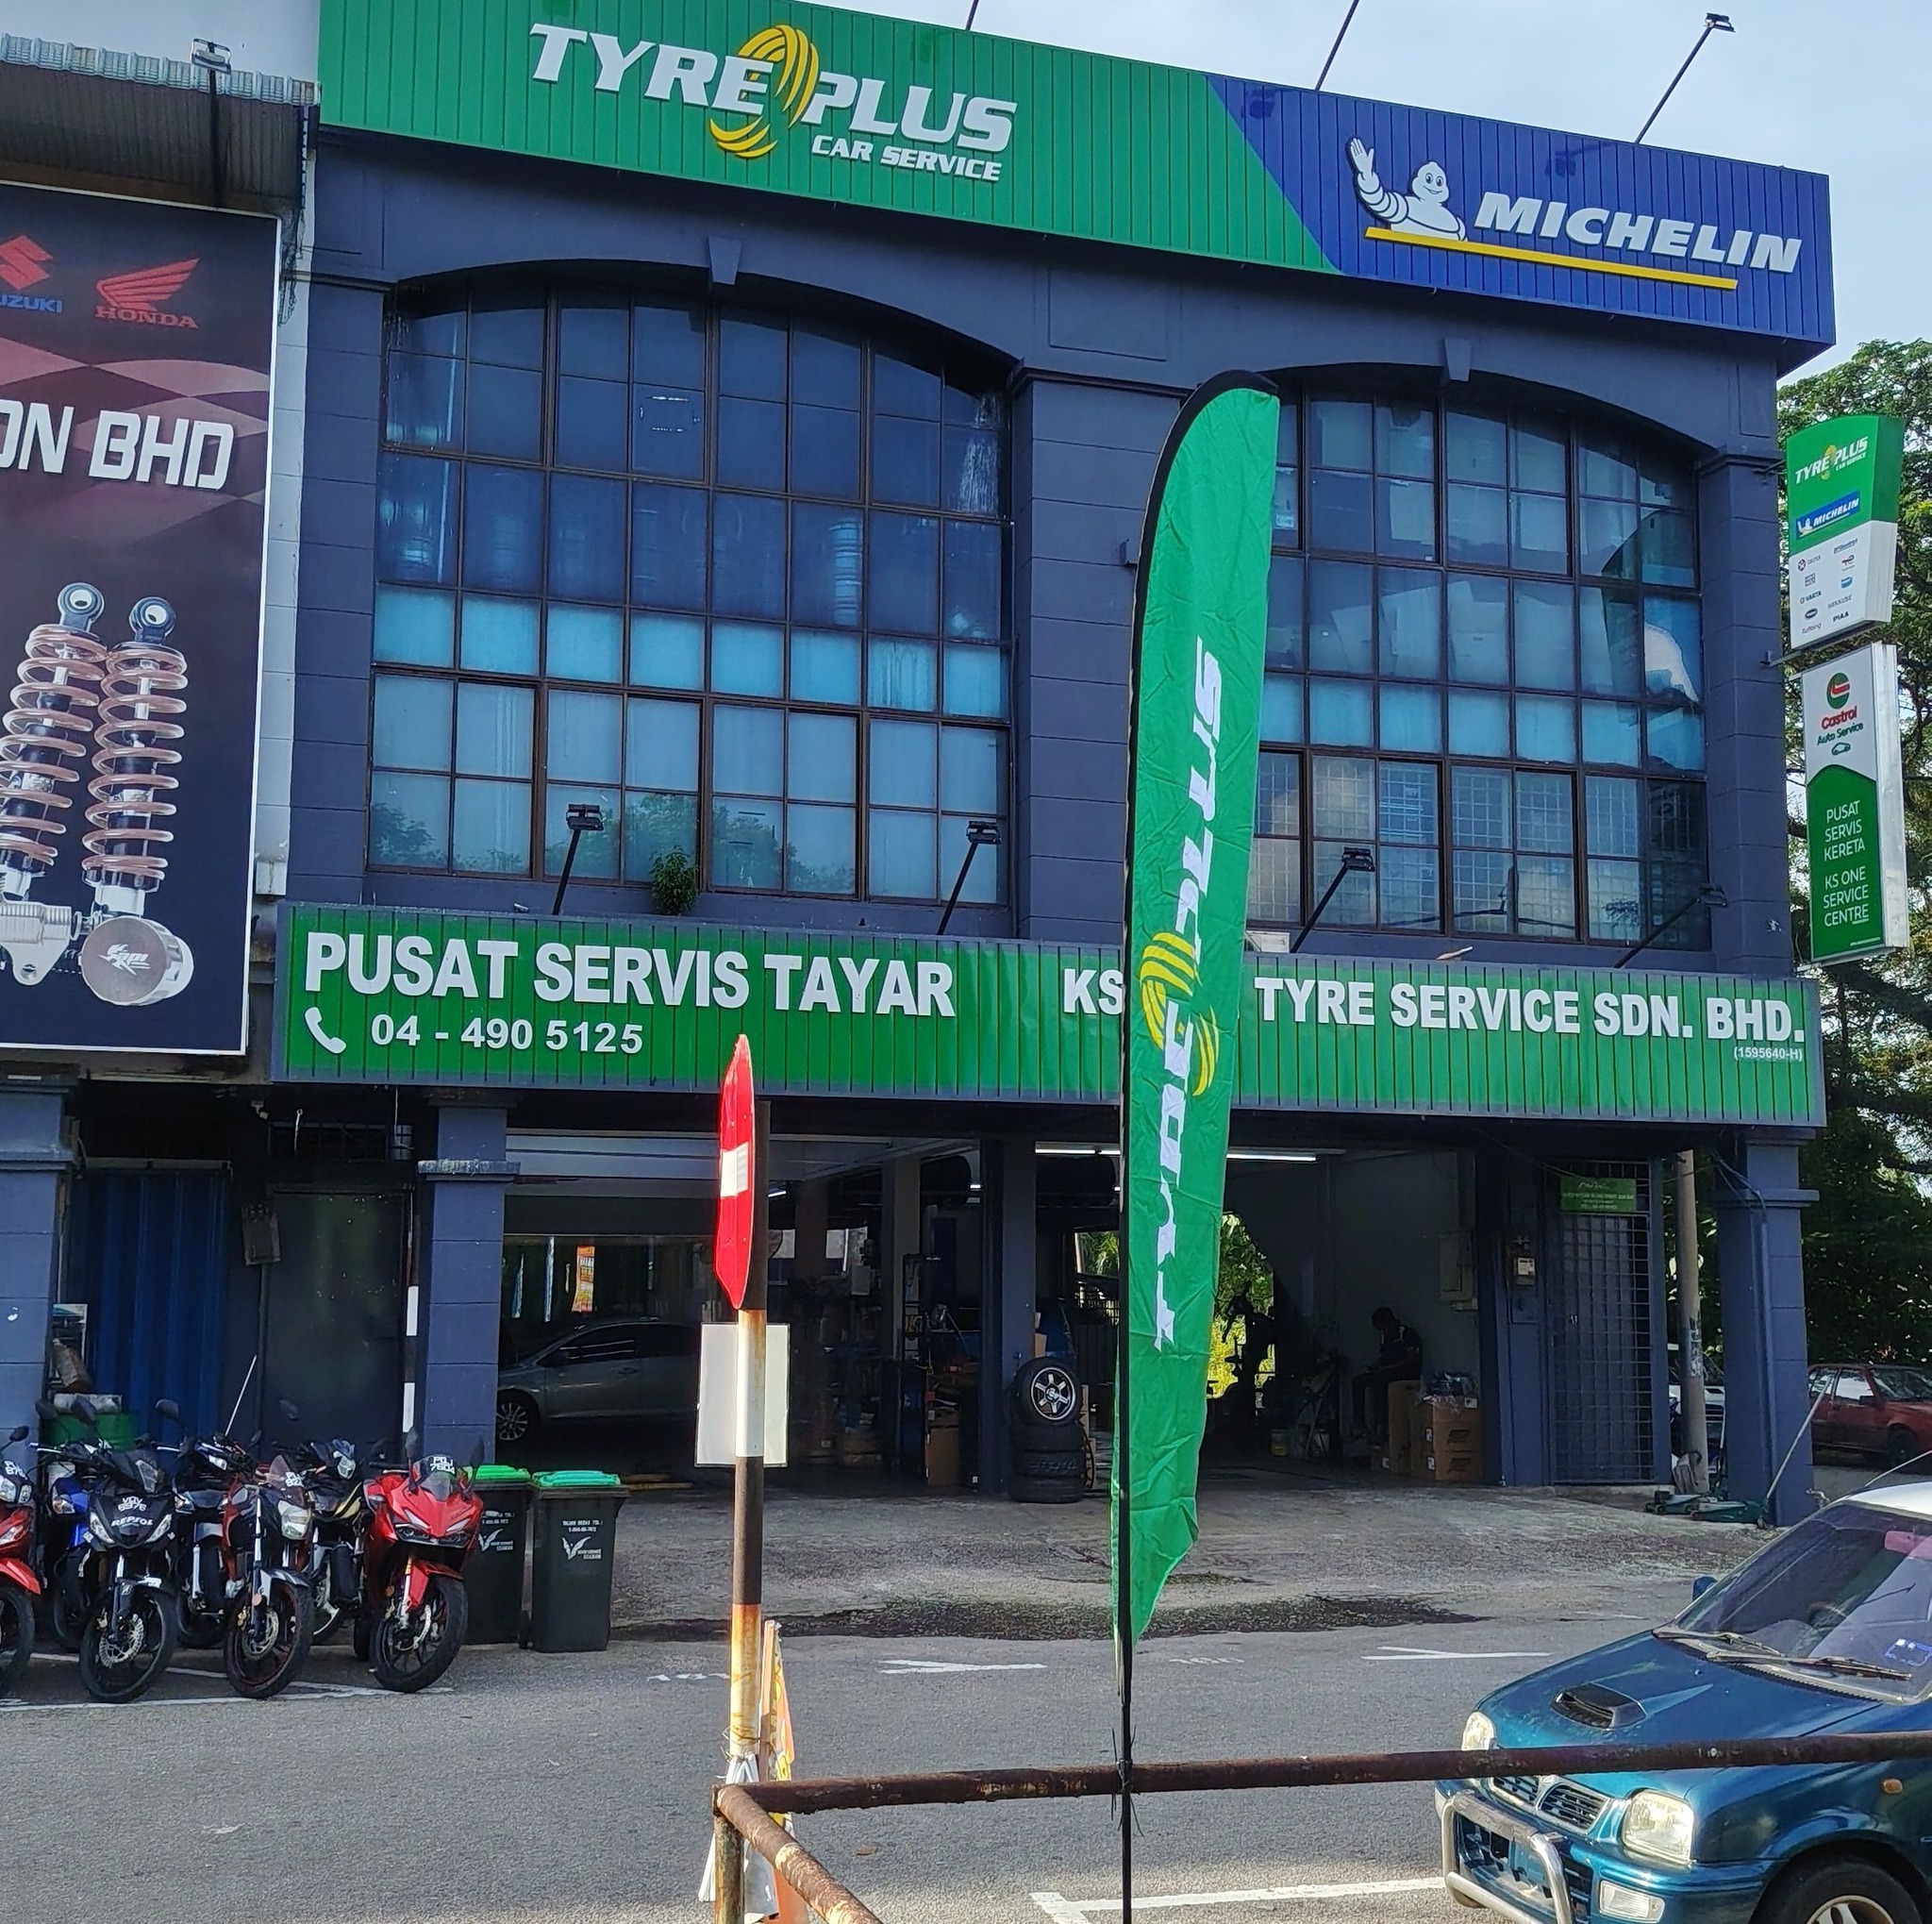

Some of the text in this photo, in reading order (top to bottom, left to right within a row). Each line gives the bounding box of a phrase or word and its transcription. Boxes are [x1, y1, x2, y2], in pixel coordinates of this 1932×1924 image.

[811, 135, 1002, 182] CAR SERVICE
[1474, 192, 1802, 273] MICHELIN
[95, 306, 199, 328] HONDA
[89, 410, 234, 490] BHD
[1813, 498, 1859, 527] MICHELIN
[1822, 706, 1857, 730] Castrol
[1817, 722, 1864, 745] Auto Service
[1826, 800, 1860, 823] PUSAT
[1824, 819, 1862, 843] SERVIS
[1824, 838, 1865, 862] KERETA
[1824, 865, 1866, 890] KS ONE
[1824, 884, 1869, 909] SERVICE
[1824, 903, 1869, 927] CENTRE
[305, 931, 956, 1017] PUSAT SERVIS TAYAR
[1063, 968, 1805, 1043] KS TYRE SERVICE SDN. BHD.
[371, 1013, 421, 1046] 04
[460, 1017, 533, 1050] 490
[546, 1019, 643, 1054] 5125
[111, 1515, 153, 1527] REPSOL
